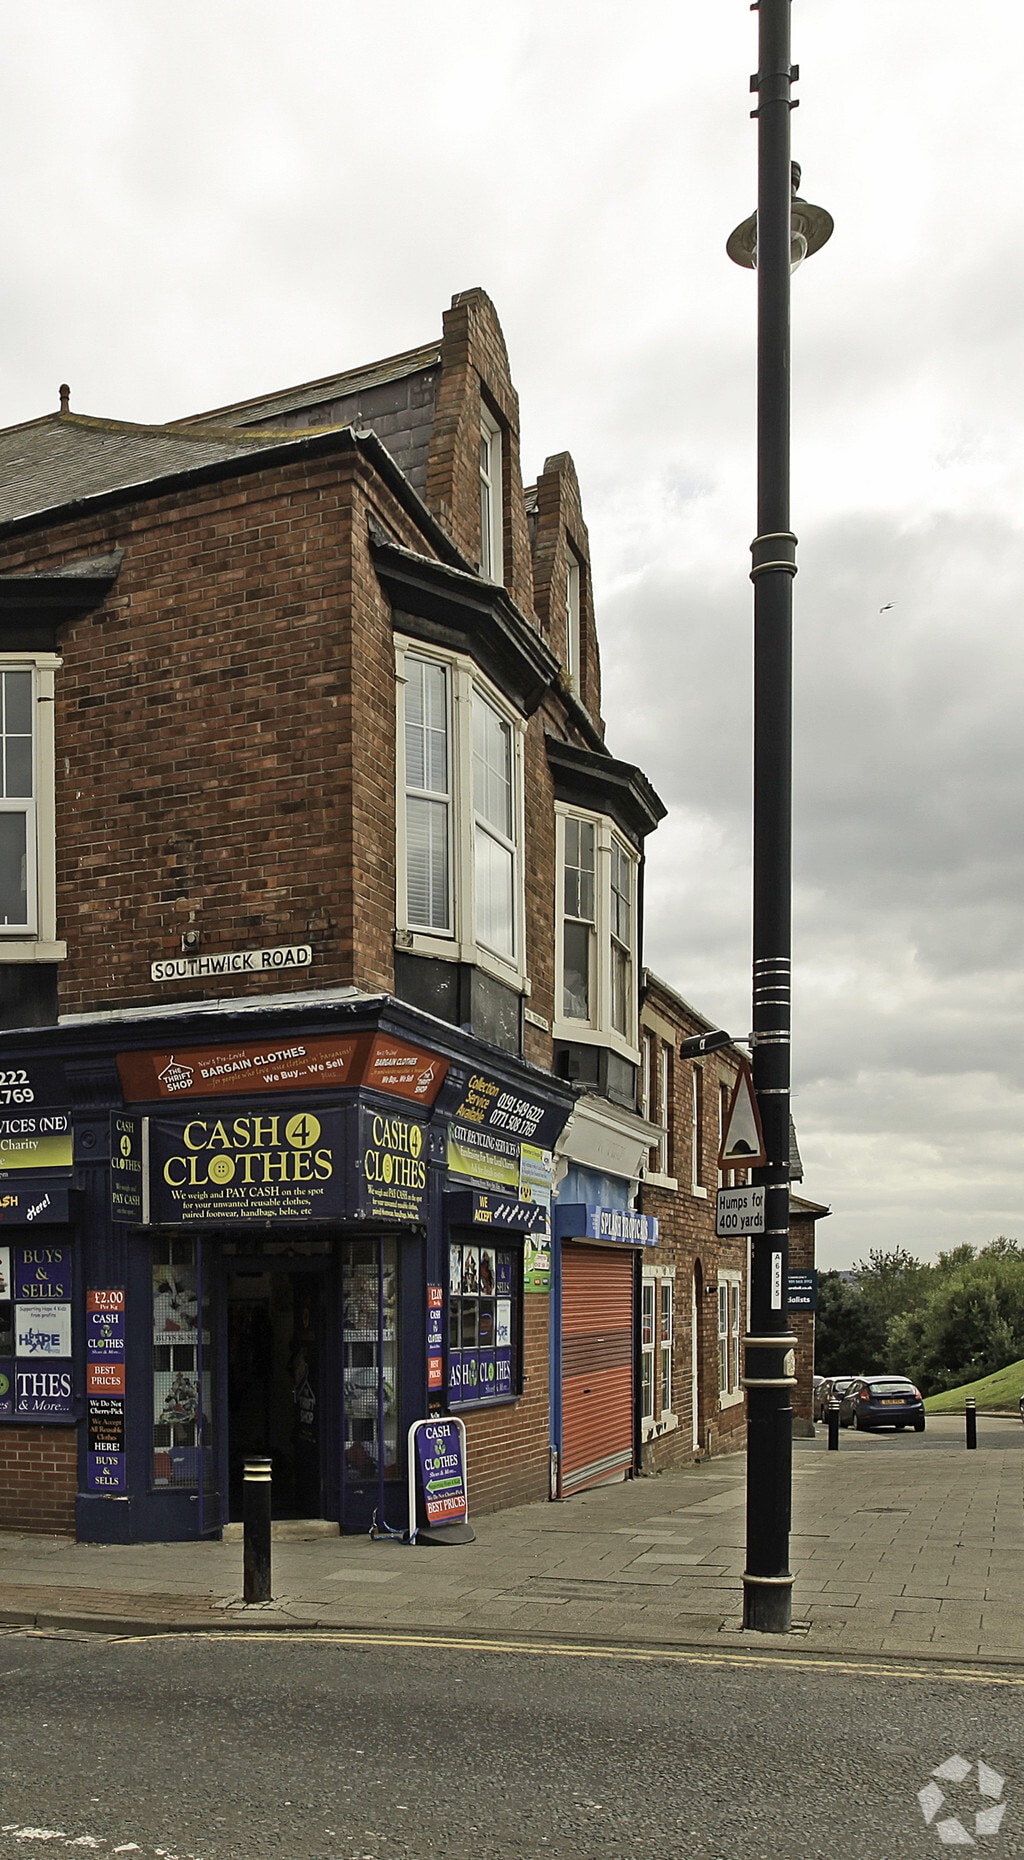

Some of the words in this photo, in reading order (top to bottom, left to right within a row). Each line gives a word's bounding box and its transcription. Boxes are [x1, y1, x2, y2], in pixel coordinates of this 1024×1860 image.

[155, 953, 254, 979] SOUTHWICK
[262, 948, 308, 968] ROAD
[200, 1059, 252, 1079] BARGAIN
[253, 1046, 306, 1066] CLOTHES
[163, 1071, 191, 1084] THRIFT
[168, 1067, 182, 1075] THE
[263, 1074, 280, 1083] We
[307, 1063, 324, 1073] We
[325, 1058, 344, 1069] Sell
[167, 1079, 193, 1092] SHOP
[468, 1074, 500, 1097] Collection
[466, 1089, 490, 1110] Service
[456, 1103, 485, 1124] Available
[497, 1092, 517, 1113] 0191
[514, 1100, 530, 1117] 549
[526, 1105, 545, 1124] 6222
[39, 1115, 68, 1132] (NE)
[116, 1119, 134, 1133] CASH
[489, 1109, 509, 1128] 0771
[506, 1116, 521, 1132] 508
[518, 1120, 537, 1137] 1769
[183, 1115, 282, 1151] CASH
[373, 1115, 409, 1153] CASH
[0, 1139, 39, 1151] Charity
[111, 1157, 141, 1172] CLOTHES
[163, 1149, 333, 1187] CLOTHES
[365, 1149, 426, 1189] CLOTHES
[112, 1193, 124, 1204] PAY
[124, 1194, 141, 1206] CASH
[171, 1190, 186, 1200] We
[188, 1191, 208, 1200] weigh
[210, 1191, 224, 1199] and
[226, 1187, 247, 1198] PAY
[249, 1186, 280, 1197] CASH
[293, 1187, 306, 1196] the
[308, 1187, 324, 1197] spot
[26, 1193, 51, 1221] Here!
[183, 1201, 193, 1209] for
[195, 1202, 212, 1211] your
[213, 1200, 249, 1209] unwanted
[250, 1198, 281, 1207] reusable
[282, 1197, 311, 1206] clothes,
[479, 1196, 488, 1208] WE
[720, 1196, 748, 1211] Humps
[752, 1192, 763, 1207] for
[182, 1210, 205, 1220] paired
[206, 1209, 239, 1219] footwear,
[240, 1207, 278, 1218] handbags,
[279, 1206, 299, 1216] belts,
[300, 1207, 312, 1215] etc
[474, 1209, 493, 1223] ACCEPT
[601, 1212, 622, 1237] SPLASH
[720, 1214, 738, 1228] 400
[740, 1212, 763, 1230] yards
[23, 1249, 63, 1264] BUYS
[36, 1266, 49, 1280] &
[22, 1283, 64, 1298] SELLS
[95, 1291, 123, 1304] £2.00
[92, 1314, 119, 1324] CASH
[19, 1331, 60, 1350] HOPE
[88, 1338, 124, 1348] CLOTHES
[94, 1366, 115, 1375] BEST
[91, 1376, 121, 1385] PRICES
[18, 1400, 28, 1411] &
[32, 1399, 70, 1411] More...
[426, 1424, 451, 1440] CASH
[94, 1442, 120, 1451] HERE!
[96, 1456, 118, 1465] BUYS
[424, 1454, 458, 1471] CLOTHES
[102, 1467, 110, 1475] &
[95, 1477, 119, 1485] SELLS
[427, 1500, 443, 1514] BEST
[443, 1495, 466, 1511] PRICES
